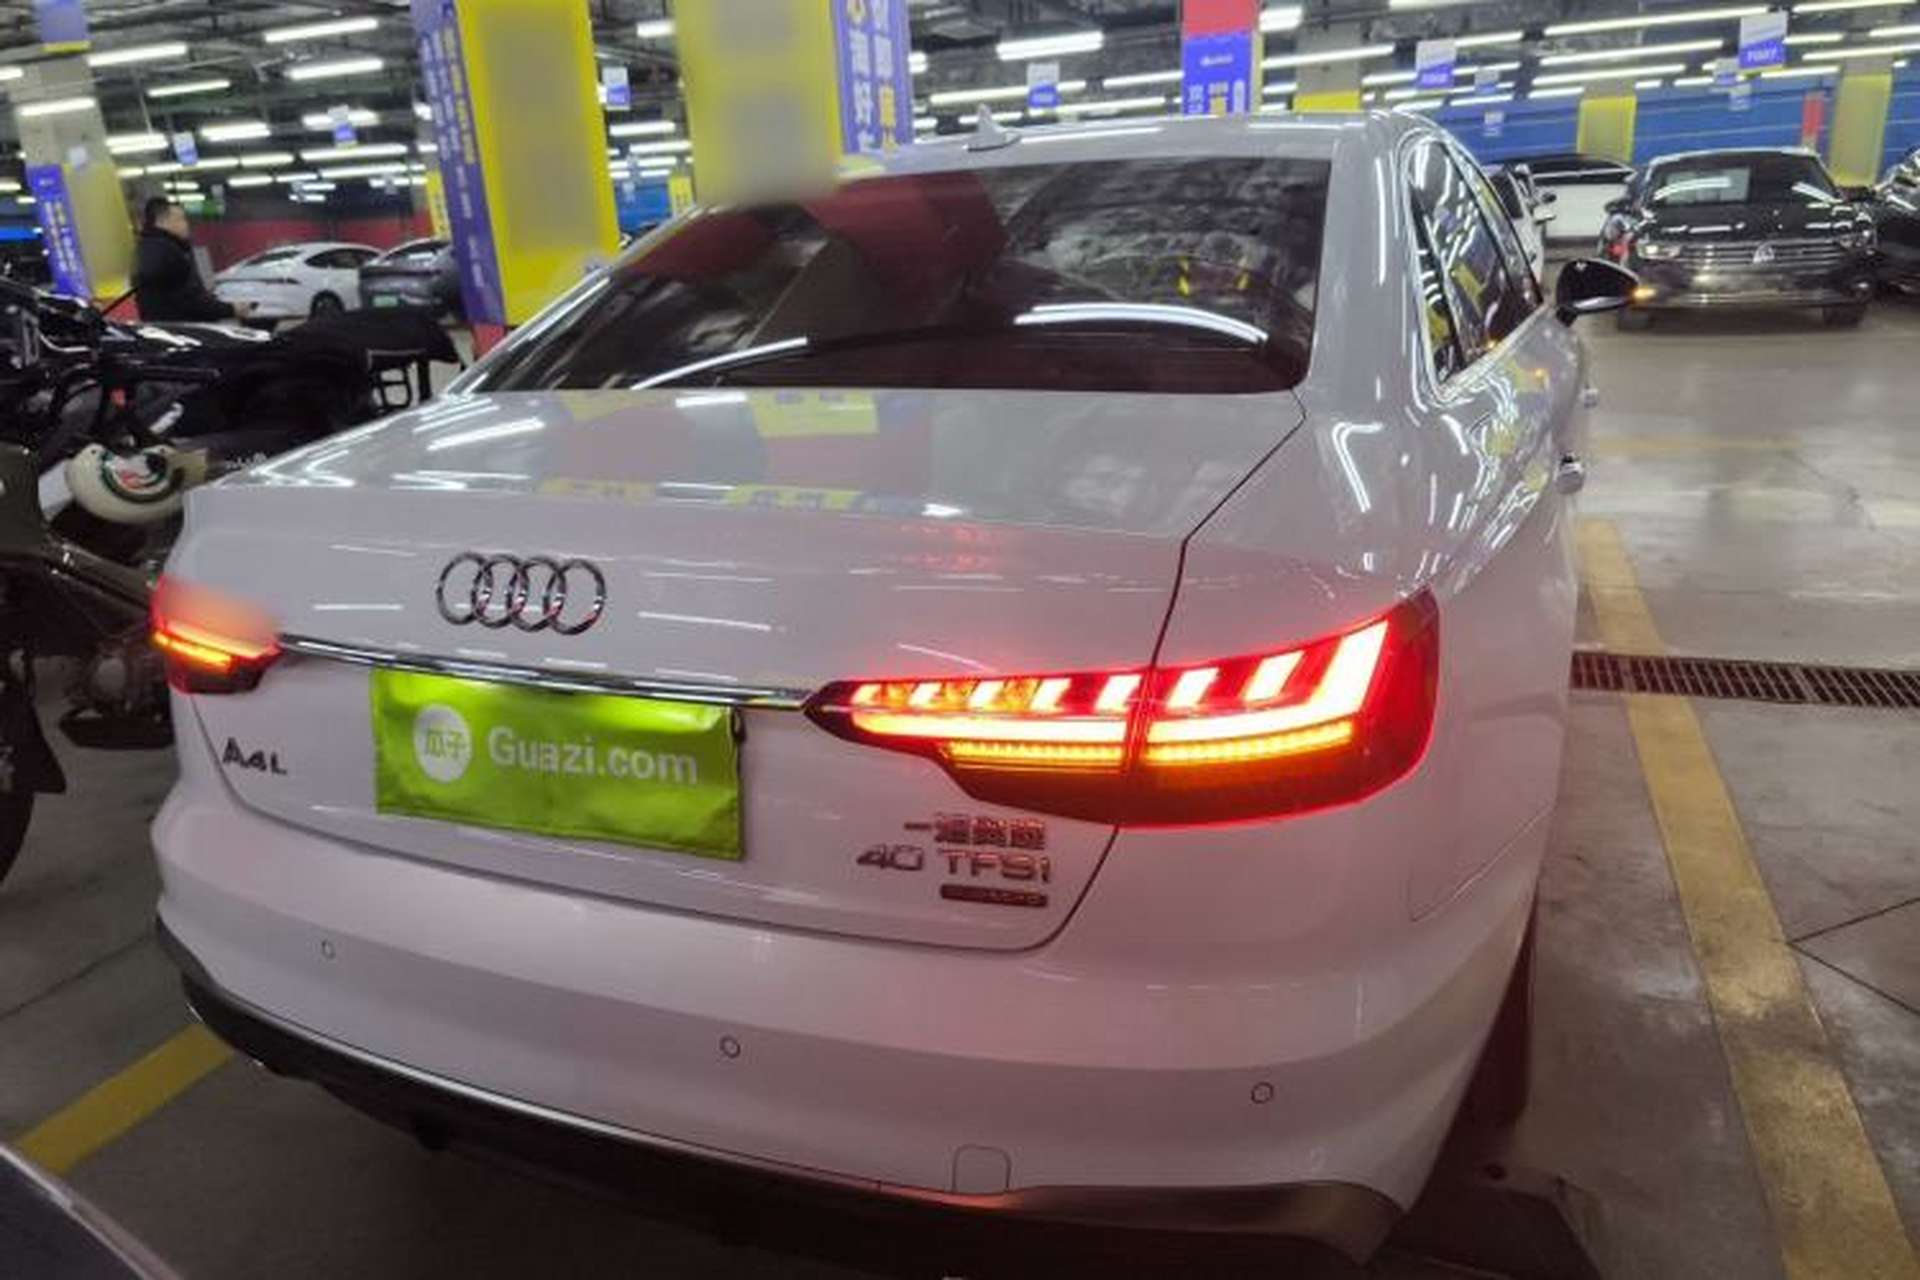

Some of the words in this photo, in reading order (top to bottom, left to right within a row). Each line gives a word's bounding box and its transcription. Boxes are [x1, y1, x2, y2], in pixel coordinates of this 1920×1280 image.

[222, 736, 287, 776] A4L
[487, 726, 699, 785] Guazi.com
[855, 844, 925, 872] 40
